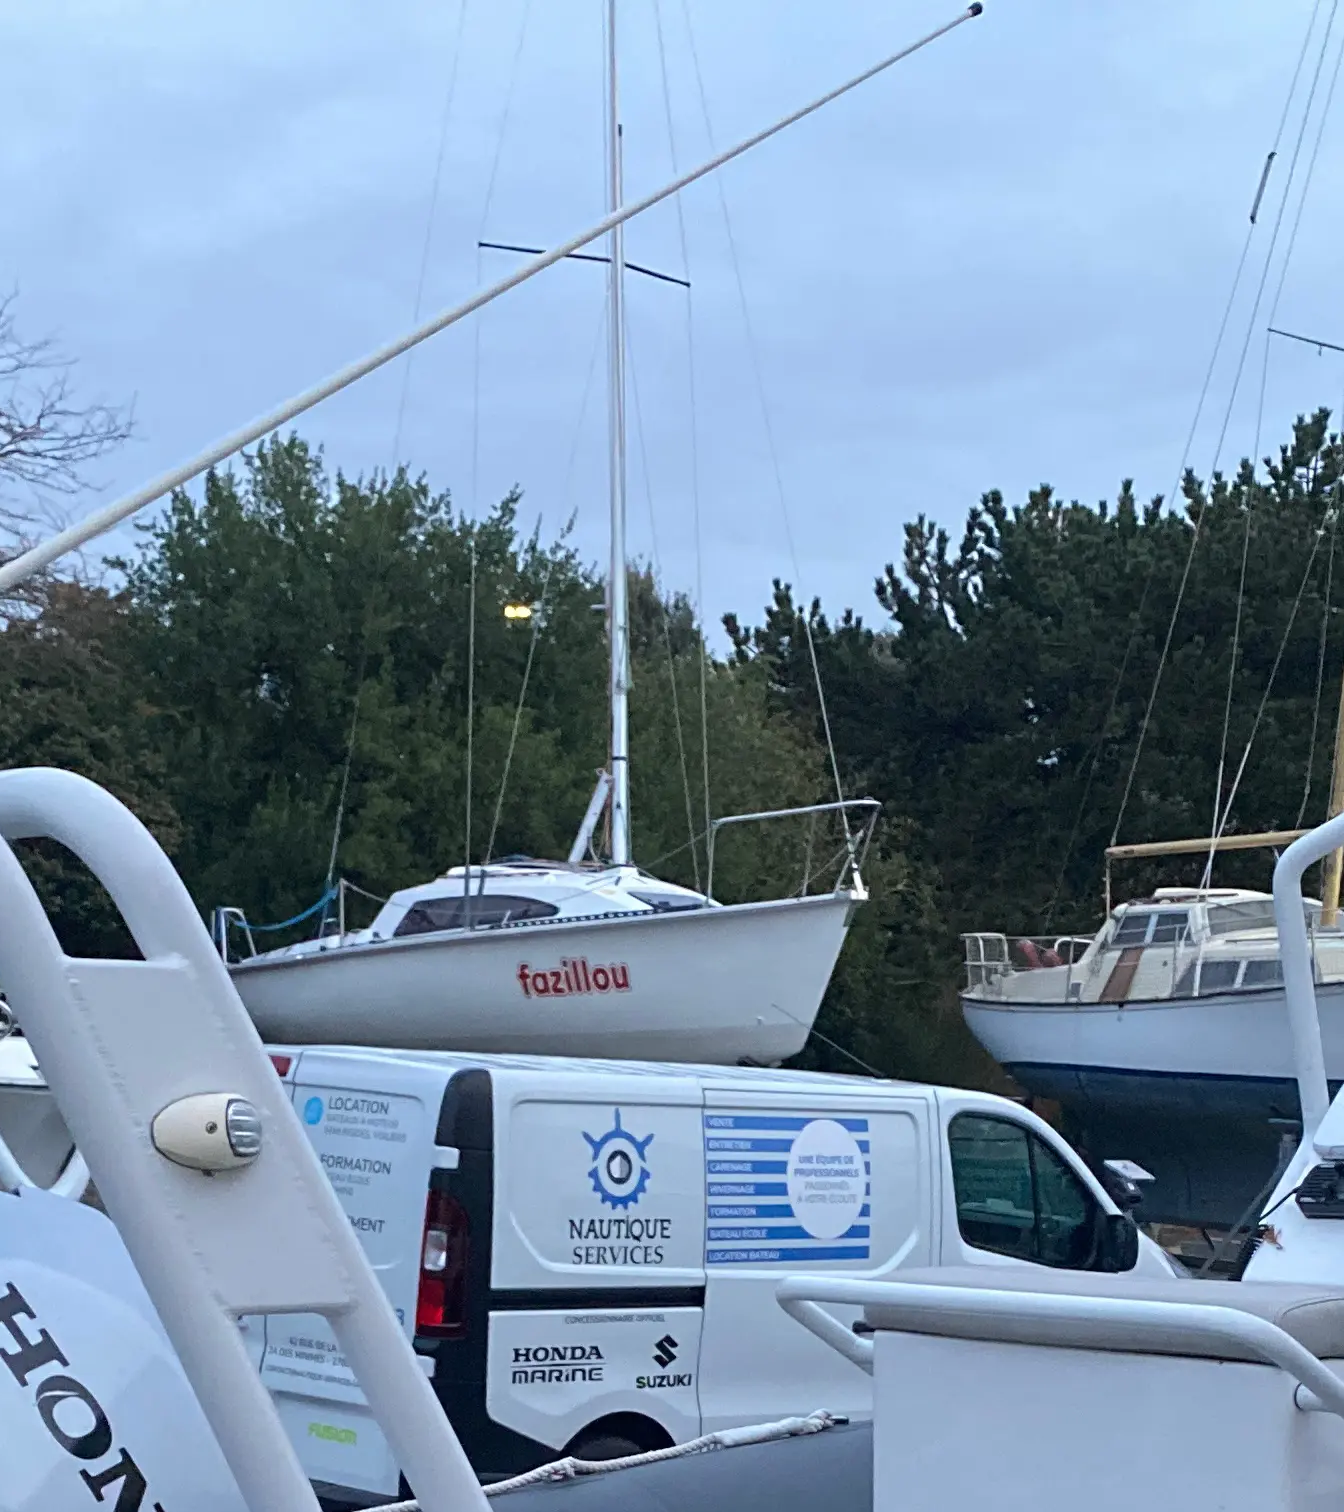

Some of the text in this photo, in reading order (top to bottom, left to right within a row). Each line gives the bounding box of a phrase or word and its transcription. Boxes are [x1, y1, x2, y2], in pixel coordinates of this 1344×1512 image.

[518, 958, 631, 997] fazillou
[328, 1096, 390, 1115] LOCATION
[320, 1153, 392, 1175] FORMATION
[709, 1206, 757, 1217] FORMATION
[709, 1229, 741, 1239] BATEAU
[572, 1245, 664, 1265] SERVICES
[709, 1250, 780, 1261] LOCATION BATEAU
[512, 1345, 605, 1363] HONDA
[635, 1373, 693, 1389] SUZUKI
